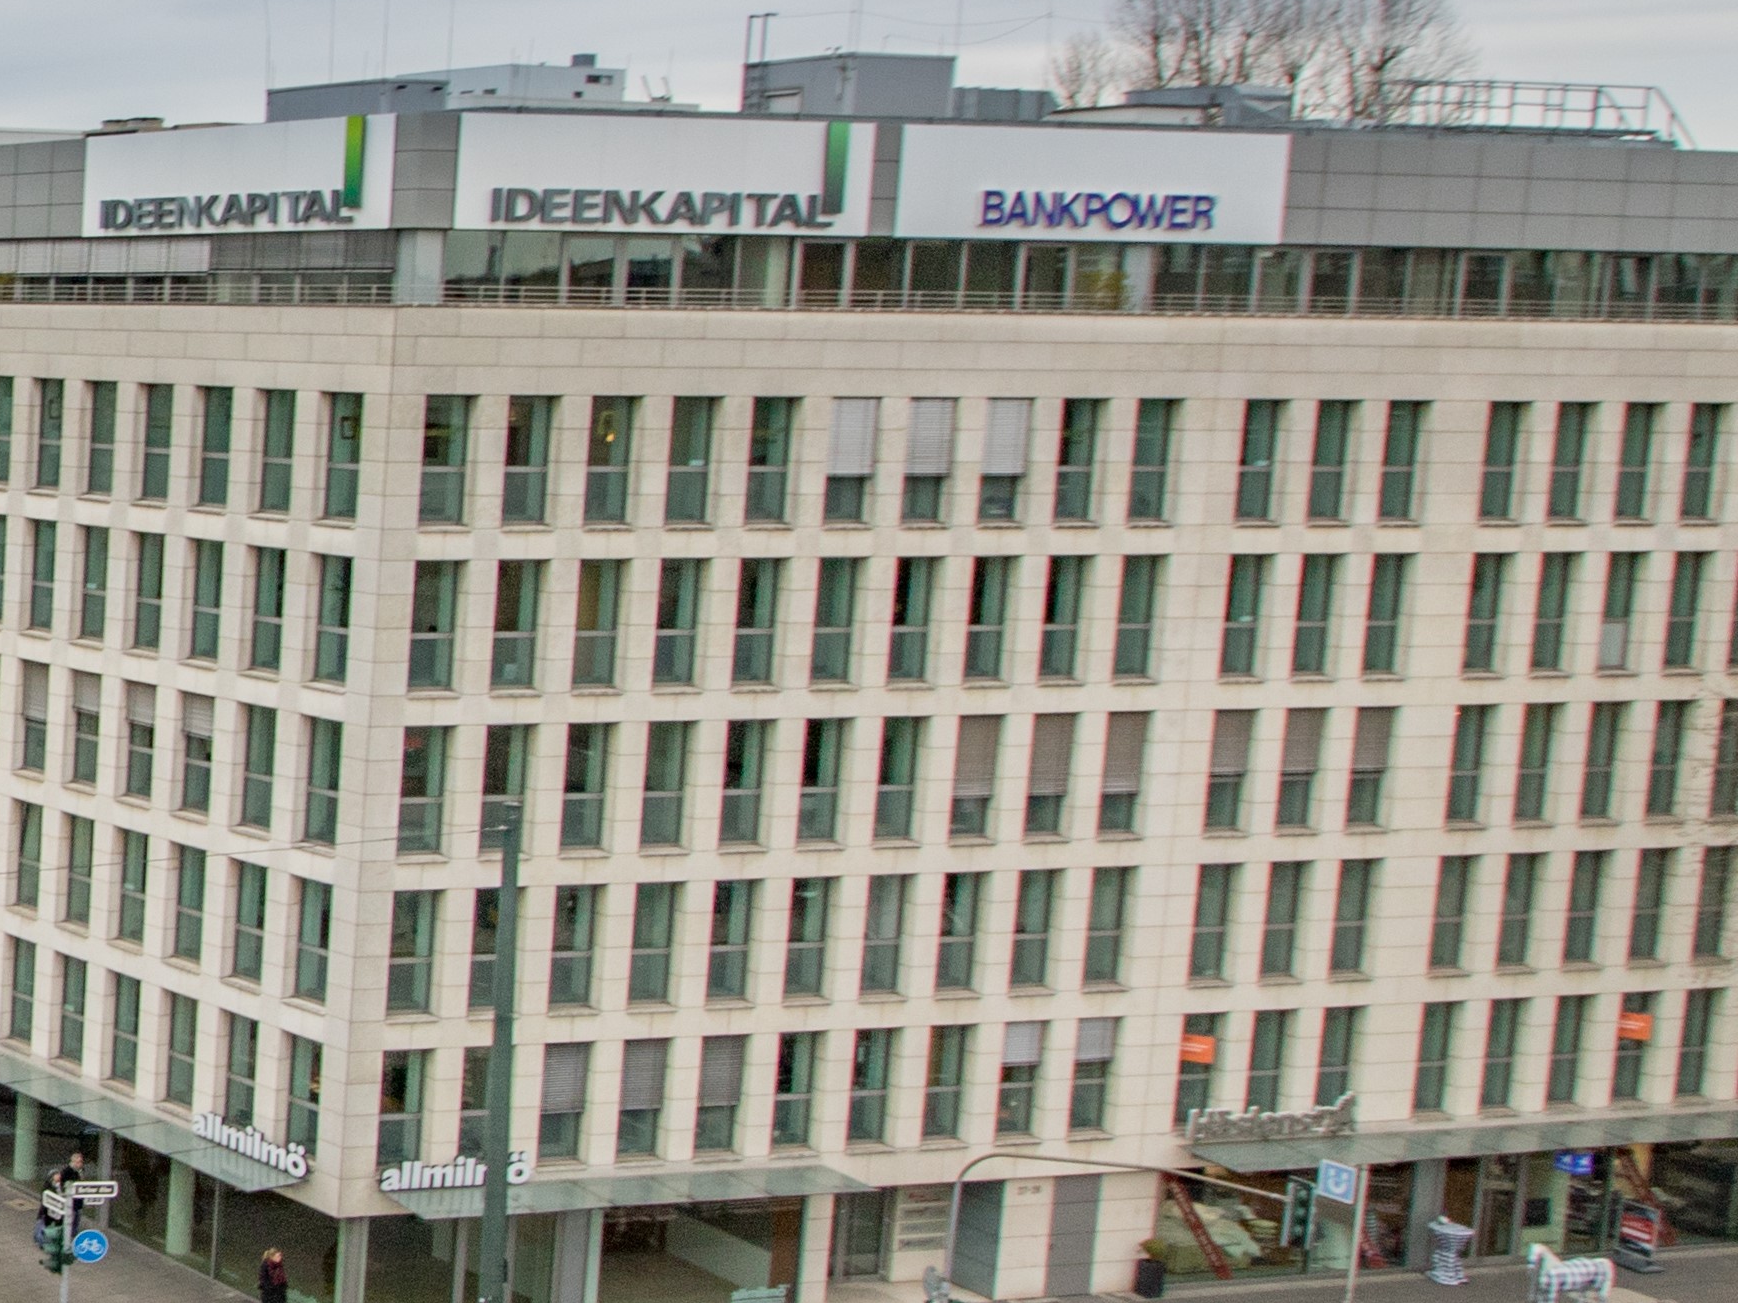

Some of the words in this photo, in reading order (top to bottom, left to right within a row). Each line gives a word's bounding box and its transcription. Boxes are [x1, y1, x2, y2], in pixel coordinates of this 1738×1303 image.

[100, 188, 353, 230] IDEENKAPITAL
[490, 187, 833, 229] IDEENKAPITAL
[980, 190, 1217, 230] BANKPOWER
[192, 1112, 308, 1178] allmilmö
